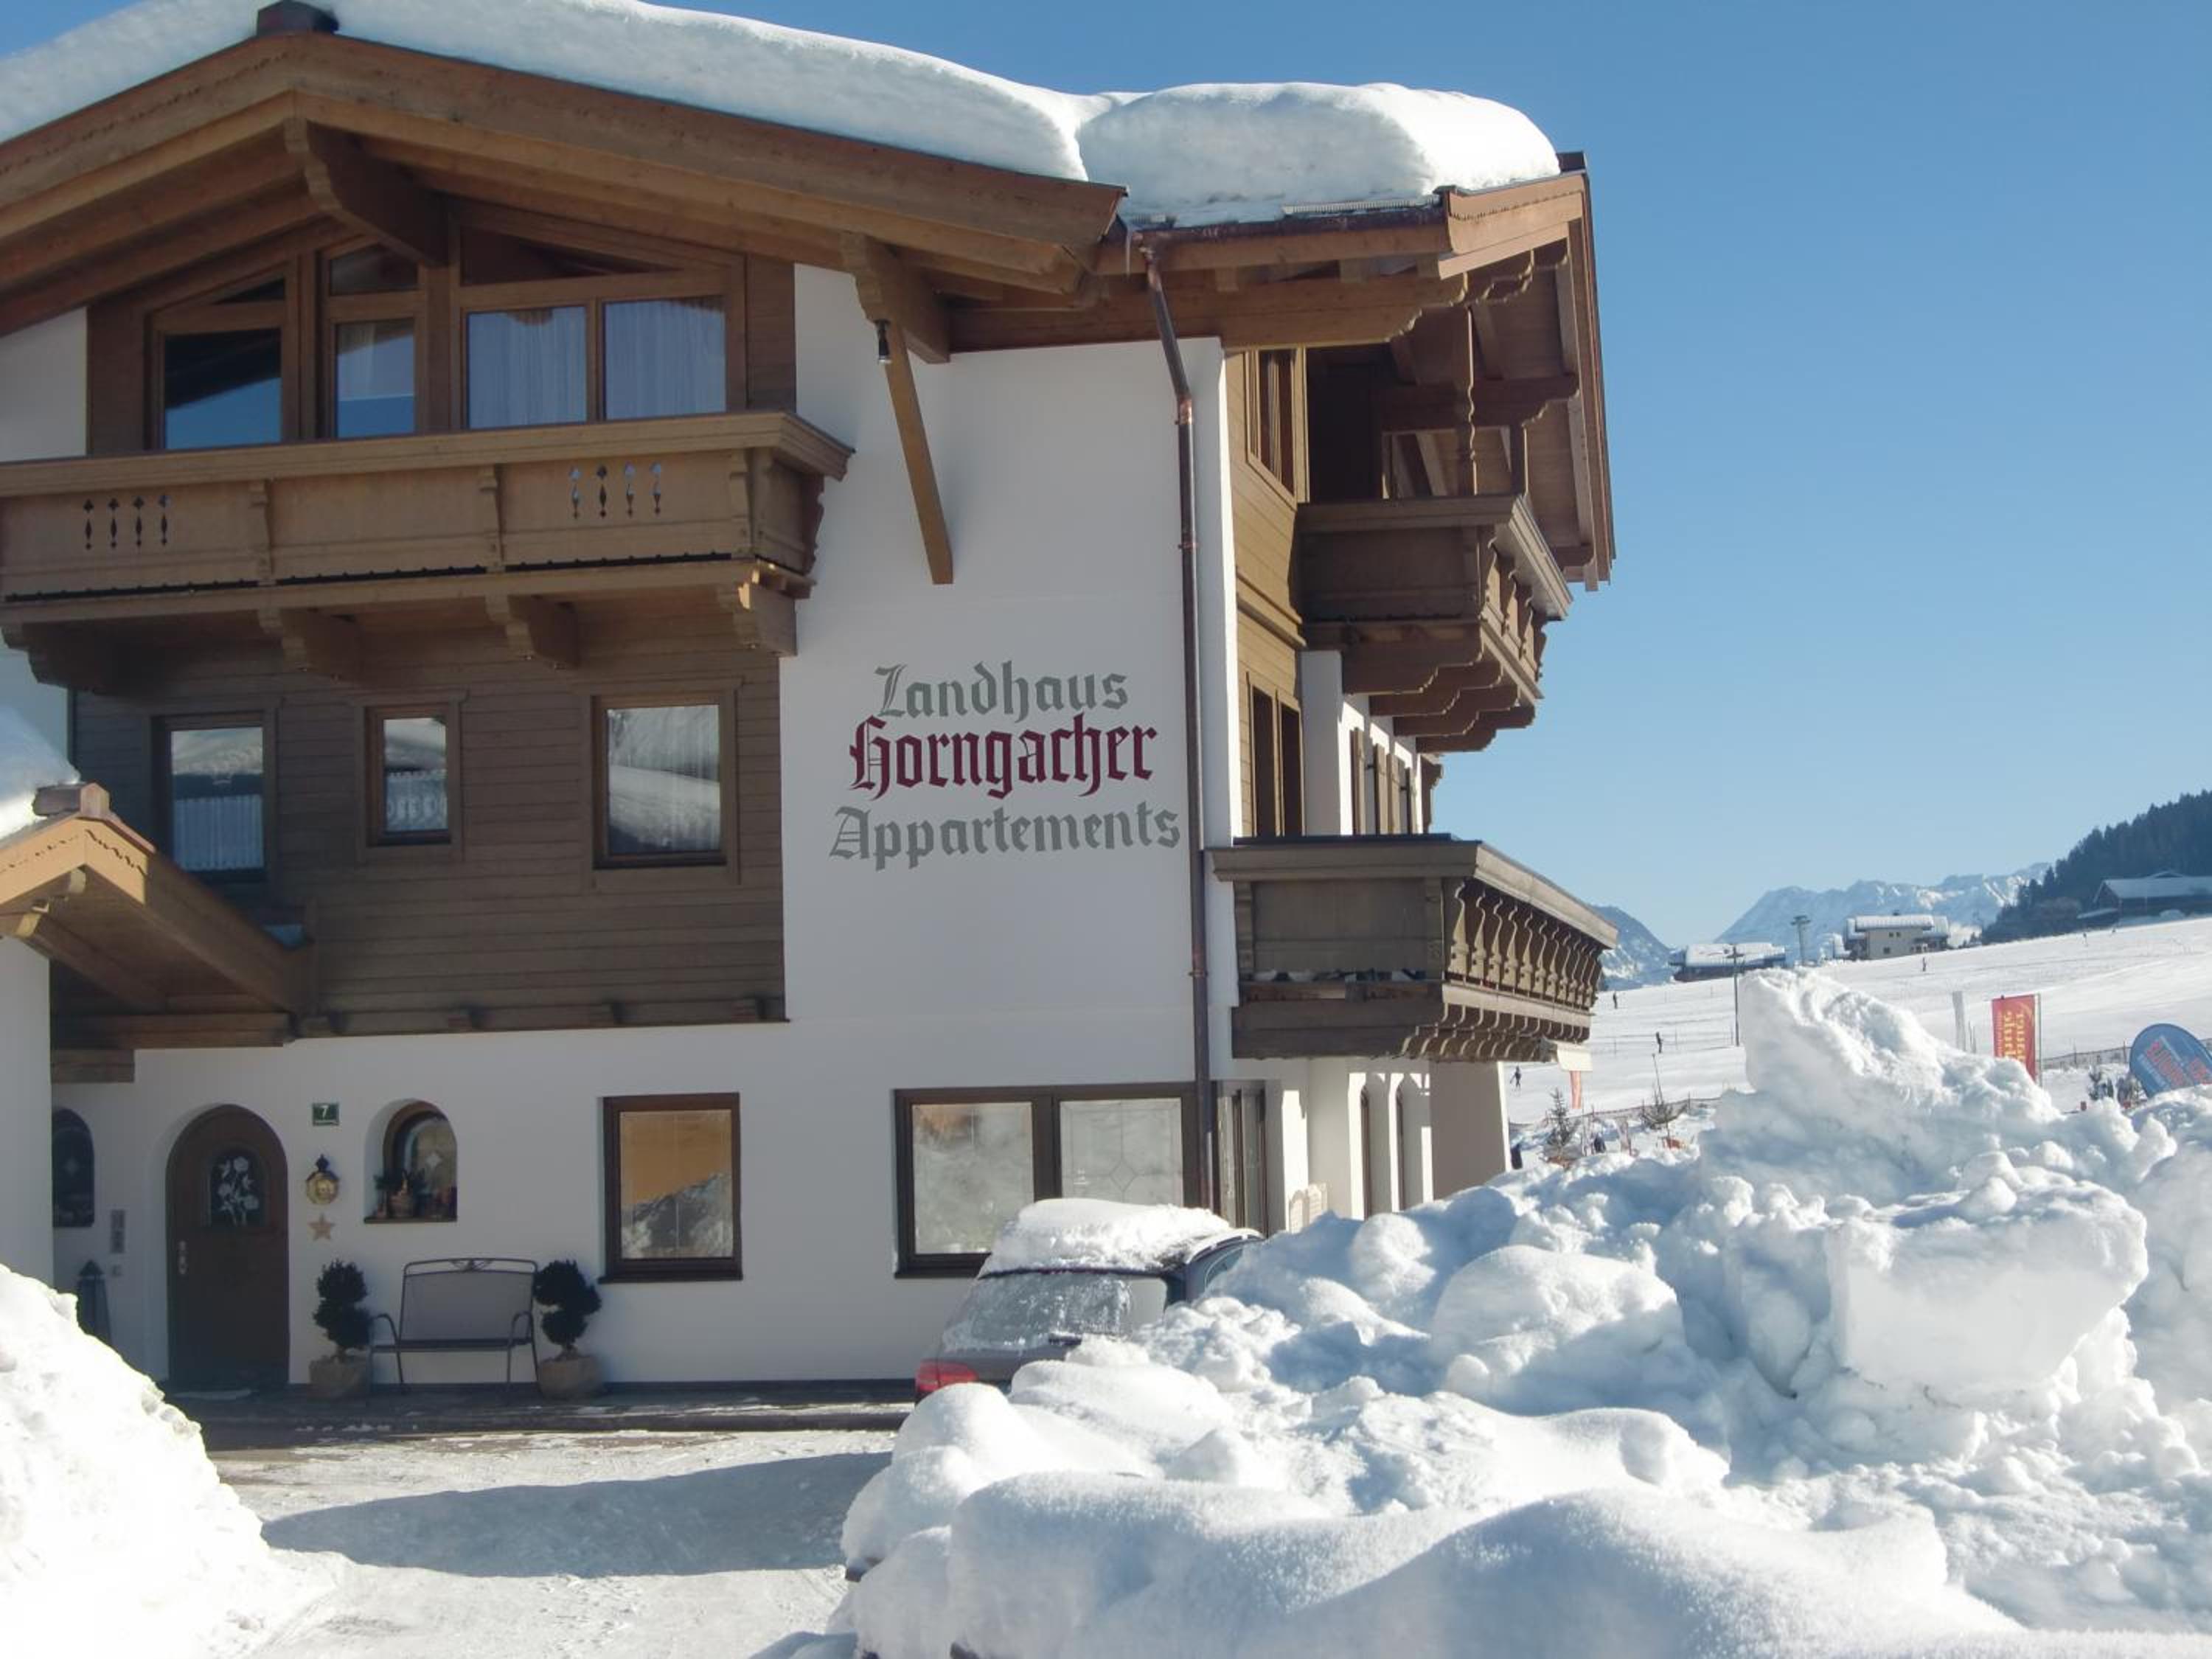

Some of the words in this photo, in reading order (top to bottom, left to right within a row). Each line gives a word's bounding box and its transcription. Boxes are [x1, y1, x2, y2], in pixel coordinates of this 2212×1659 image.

[874, 660, 1128, 723] Landhaus
[849, 712, 1158, 801] Horngacher
[829, 801, 1180, 871] Appartements
